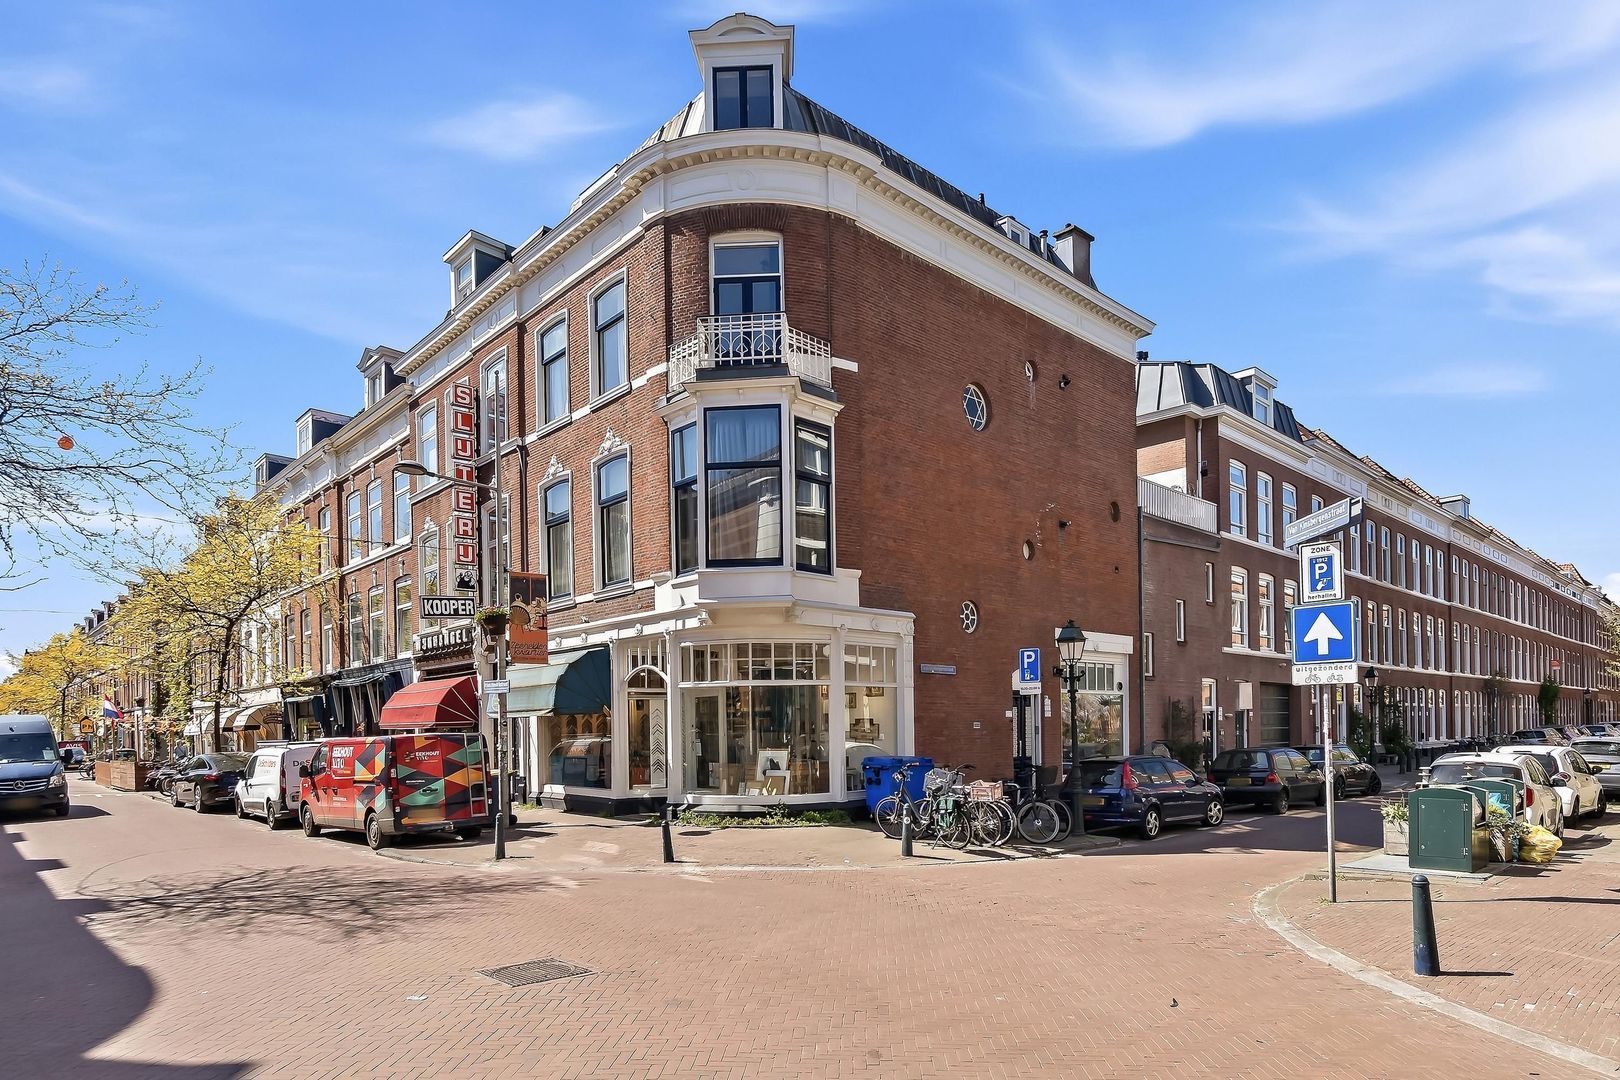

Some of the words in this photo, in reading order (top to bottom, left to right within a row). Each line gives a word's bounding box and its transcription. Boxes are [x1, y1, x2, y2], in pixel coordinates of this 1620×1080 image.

[1310, 545, 1331, 554] ZONE
[1314, 562, 1328, 580] P
[423, 599, 475, 615] KOOPER
[1023, 651, 1036, 669] P
[1295, 664, 1353, 673] uitgezonderd
